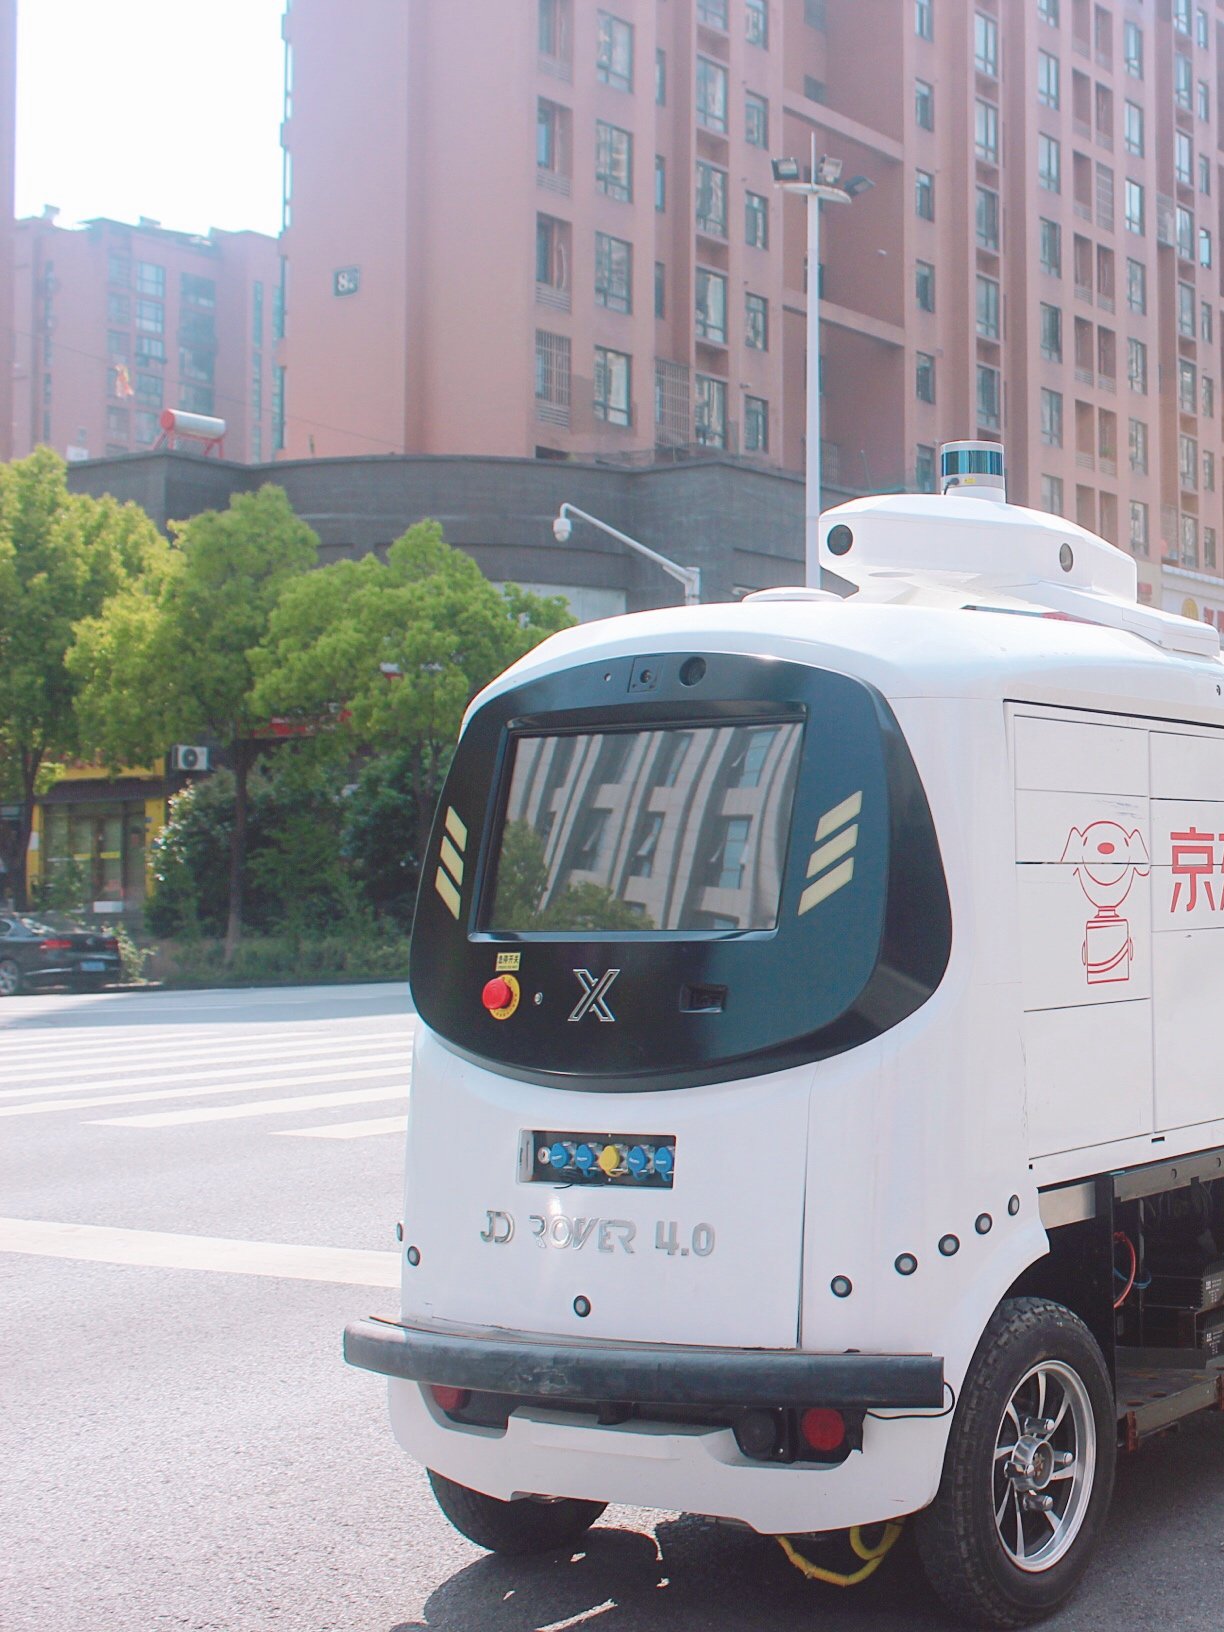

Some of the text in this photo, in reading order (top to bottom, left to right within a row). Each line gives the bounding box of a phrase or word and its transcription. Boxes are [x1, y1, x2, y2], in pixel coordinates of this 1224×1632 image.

[480, 1210, 716, 1257] JD ROVER 4.0
